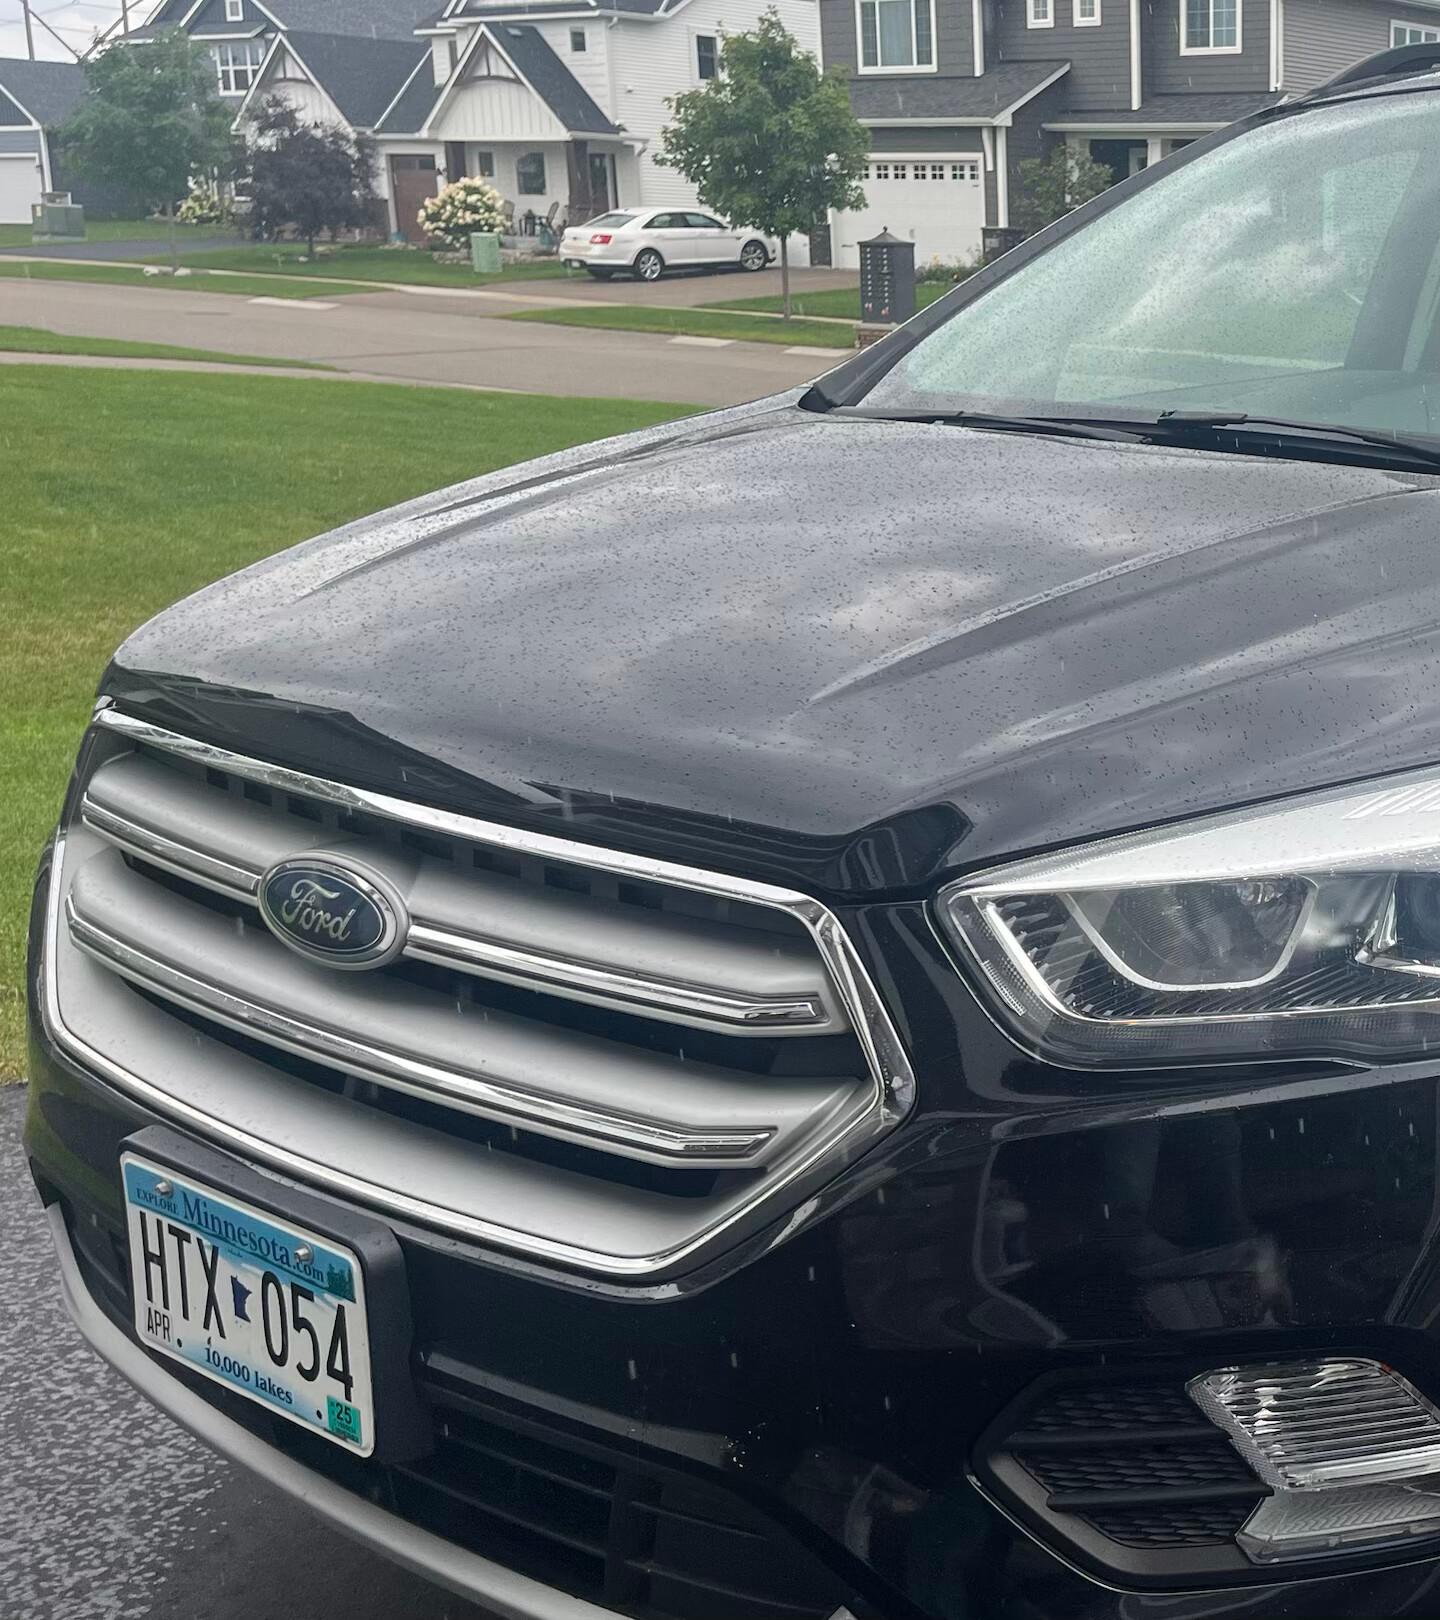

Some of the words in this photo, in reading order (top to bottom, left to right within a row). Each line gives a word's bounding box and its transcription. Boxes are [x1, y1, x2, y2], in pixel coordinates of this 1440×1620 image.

[281, 879, 356, 941] Ford
[139, 1210, 227, 1339] HTX
[261, 1270, 354, 1402] 054
[147, 1306, 171, 1342] APR
[205, 1347, 250, 1382] 10,000
[254, 1370, 293, 1404] lakes
[335, 1402, 352, 1425] 25
